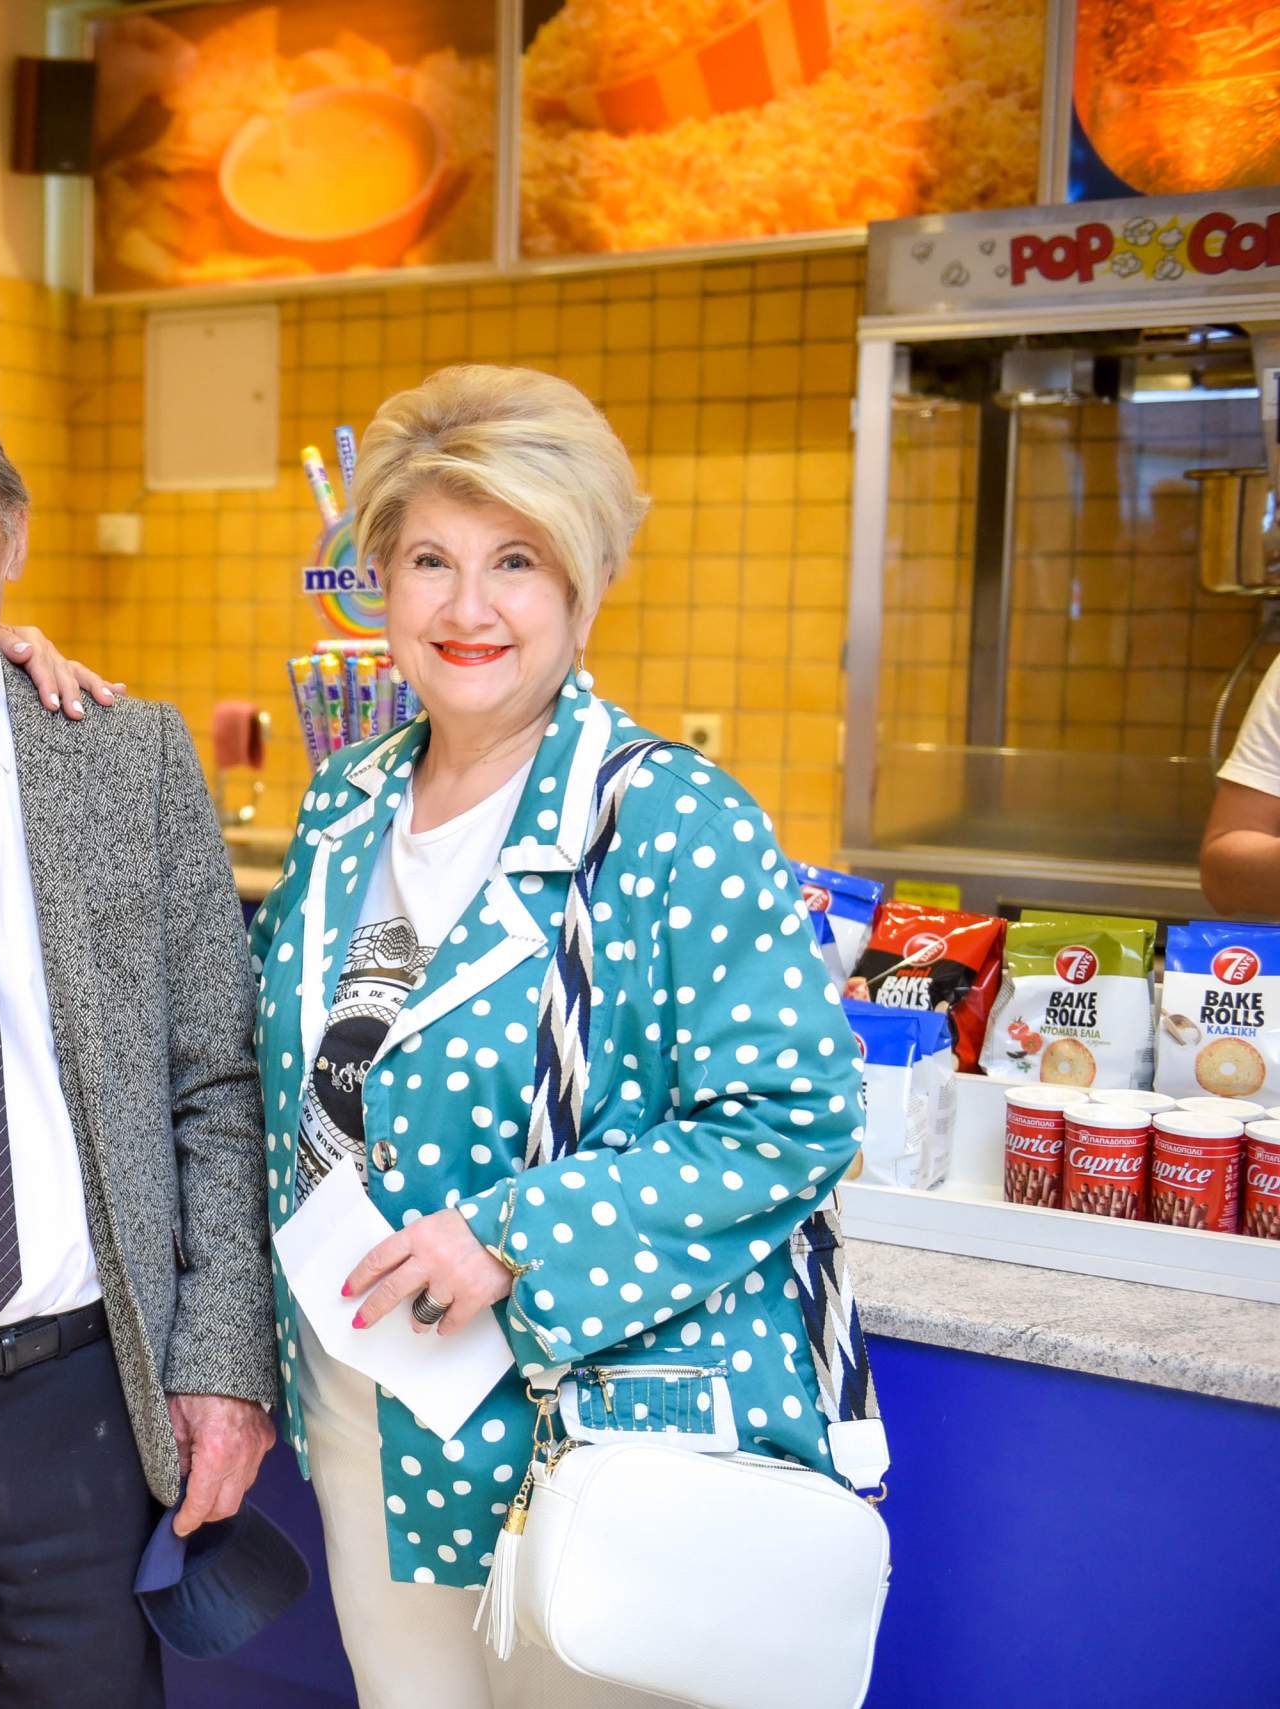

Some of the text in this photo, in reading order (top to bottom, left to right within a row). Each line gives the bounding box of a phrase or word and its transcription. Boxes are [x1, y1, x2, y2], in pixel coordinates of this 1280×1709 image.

[1010, 222, 1115, 286] POP
[1061, 950, 1086, 981] 7
[1075, 953, 1094, 980] DAYS
[1220, 952, 1247, 981] 7
[1232, 955, 1255, 980] DAYS
[369, 989, 385, 998] DE
[882, 976, 933, 994] BAKE
[875, 989, 931, 1011] ROLLS
[1049, 991, 1098, 1009] BAKE
[1205, 990, 1263, 1010] BAKE
[1045, 1008, 1098, 1028] ROLLS
[1200, 1006, 1265, 1028] ROLLS
[1206, 1026, 1257, 1037] ΚΛΑΣΙΚΗ
[1006, 1134, 1063, 1157] aprice
[1069, 1147, 1143, 1175] Caprice
[1152, 1160, 1212, 1184] aprice
[1247, 1164, 1280, 1194] Cap
